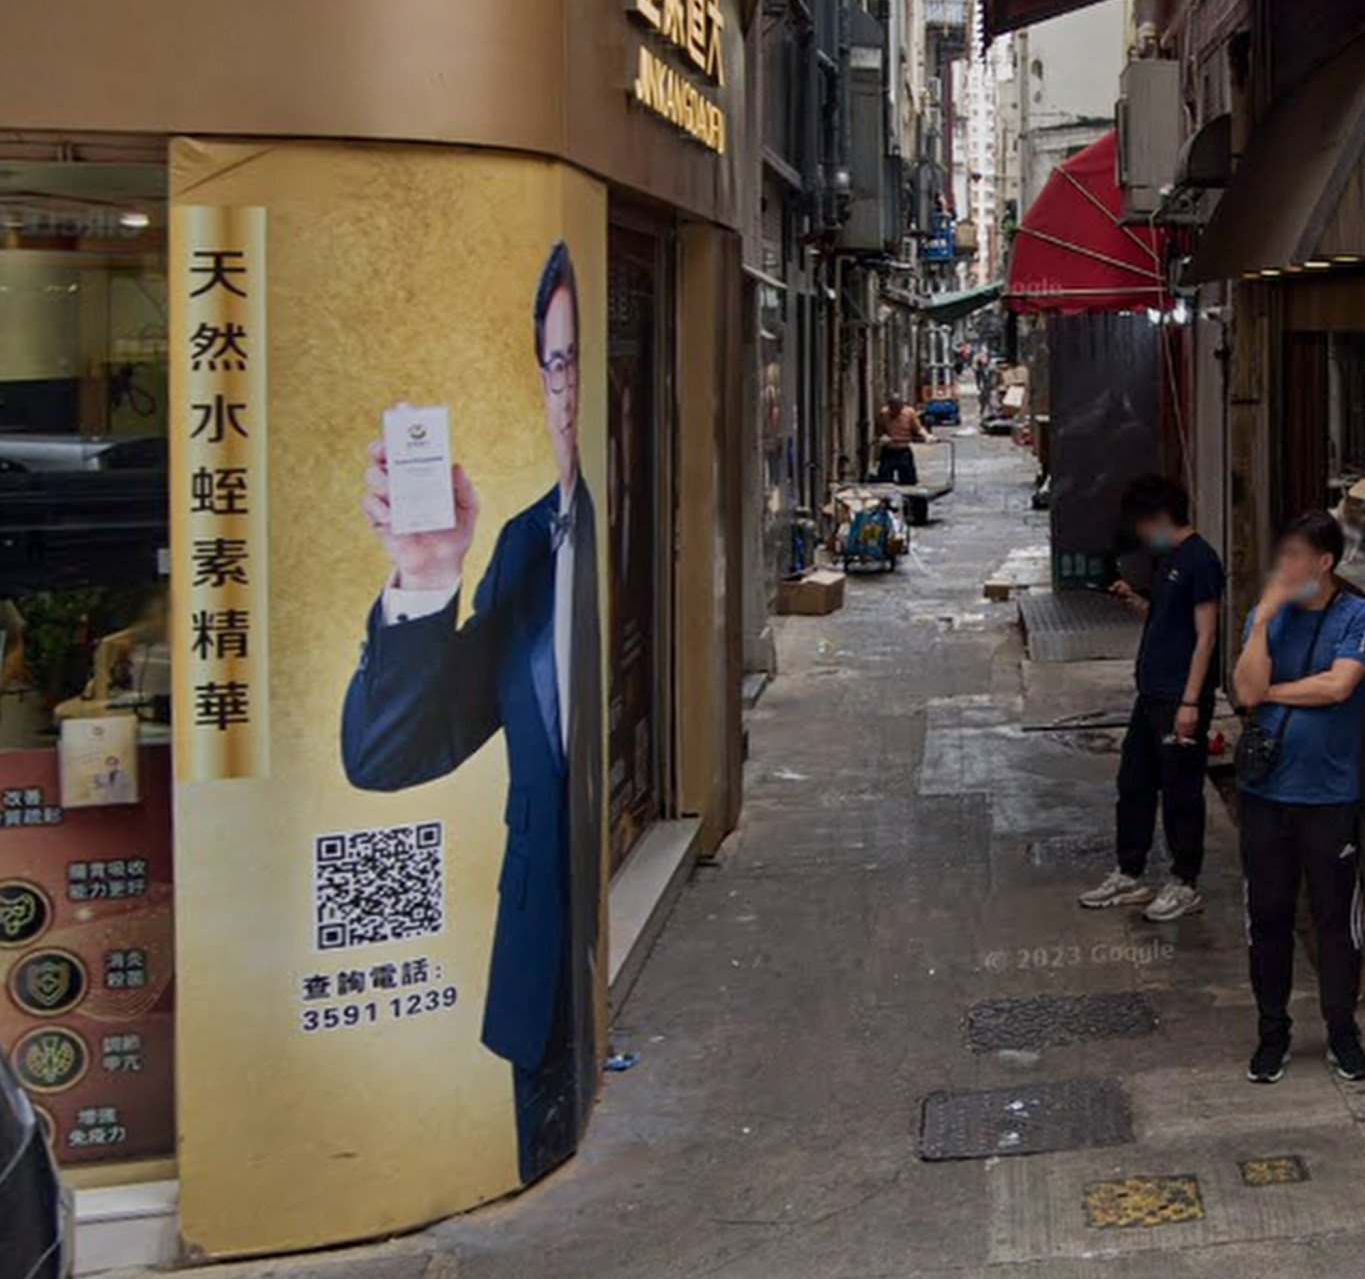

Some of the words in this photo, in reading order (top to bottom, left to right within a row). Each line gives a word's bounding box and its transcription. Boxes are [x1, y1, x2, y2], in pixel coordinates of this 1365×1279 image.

[188, 249, 250, 731] 天然水蛭素精華
[303, 1002, 377, 1031] 3591
[389, 986, 457, 1018] 1239
